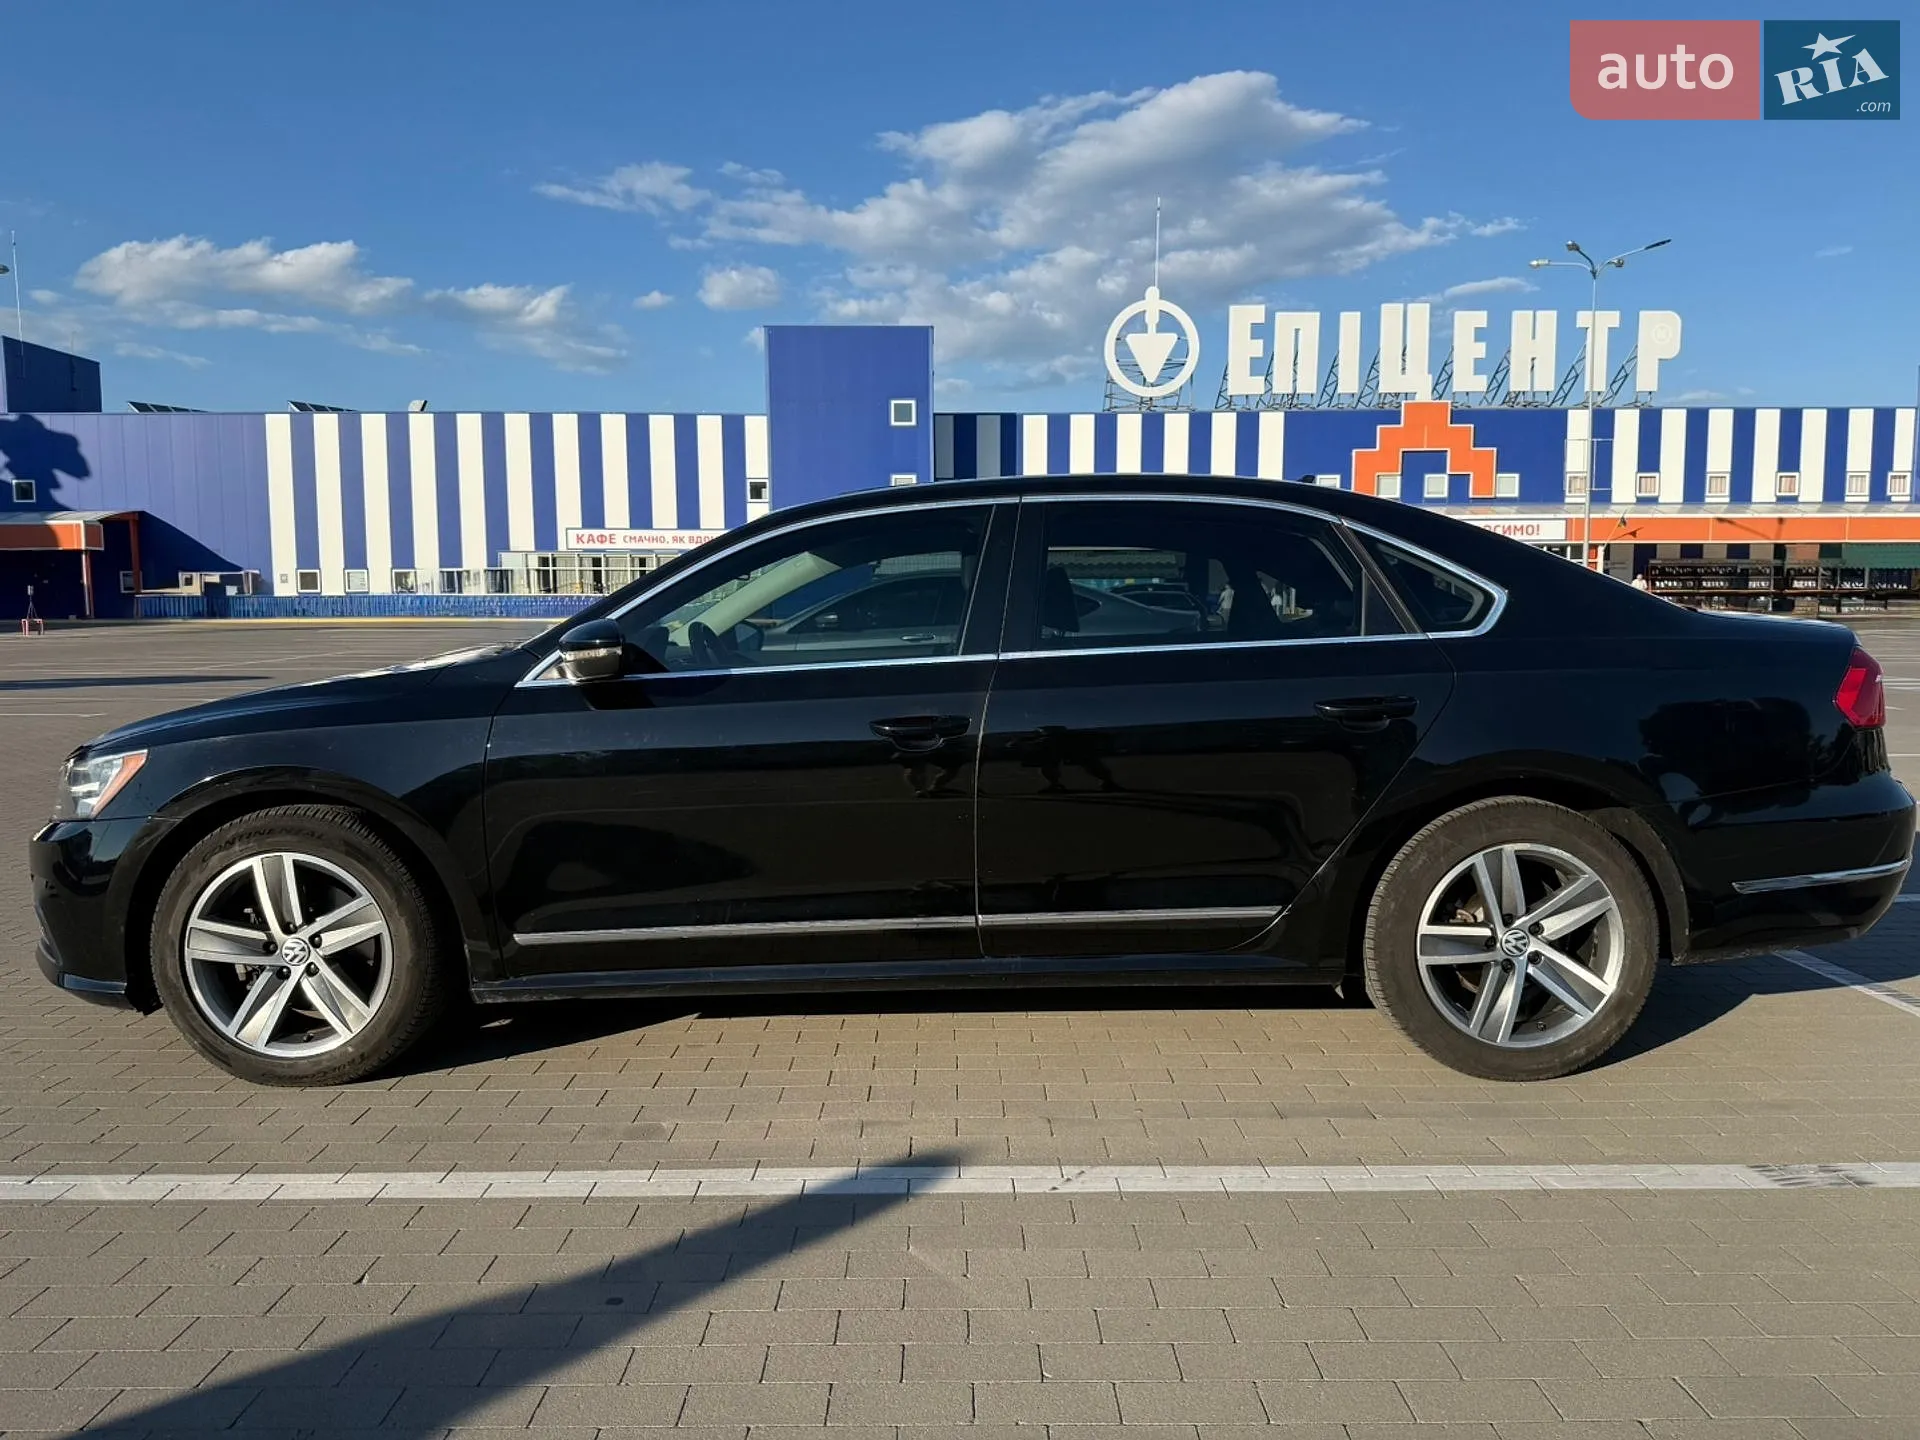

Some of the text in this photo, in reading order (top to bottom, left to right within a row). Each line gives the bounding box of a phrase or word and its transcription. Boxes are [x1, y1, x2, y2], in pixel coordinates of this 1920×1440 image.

[1227, 303, 1682, 401] ЕПІЦЕНТР
[576, 533, 617, 545] КАФЕ
[623, 535, 670, 545] СМАЧНО,
[672, 535, 686, 544] ЯК
